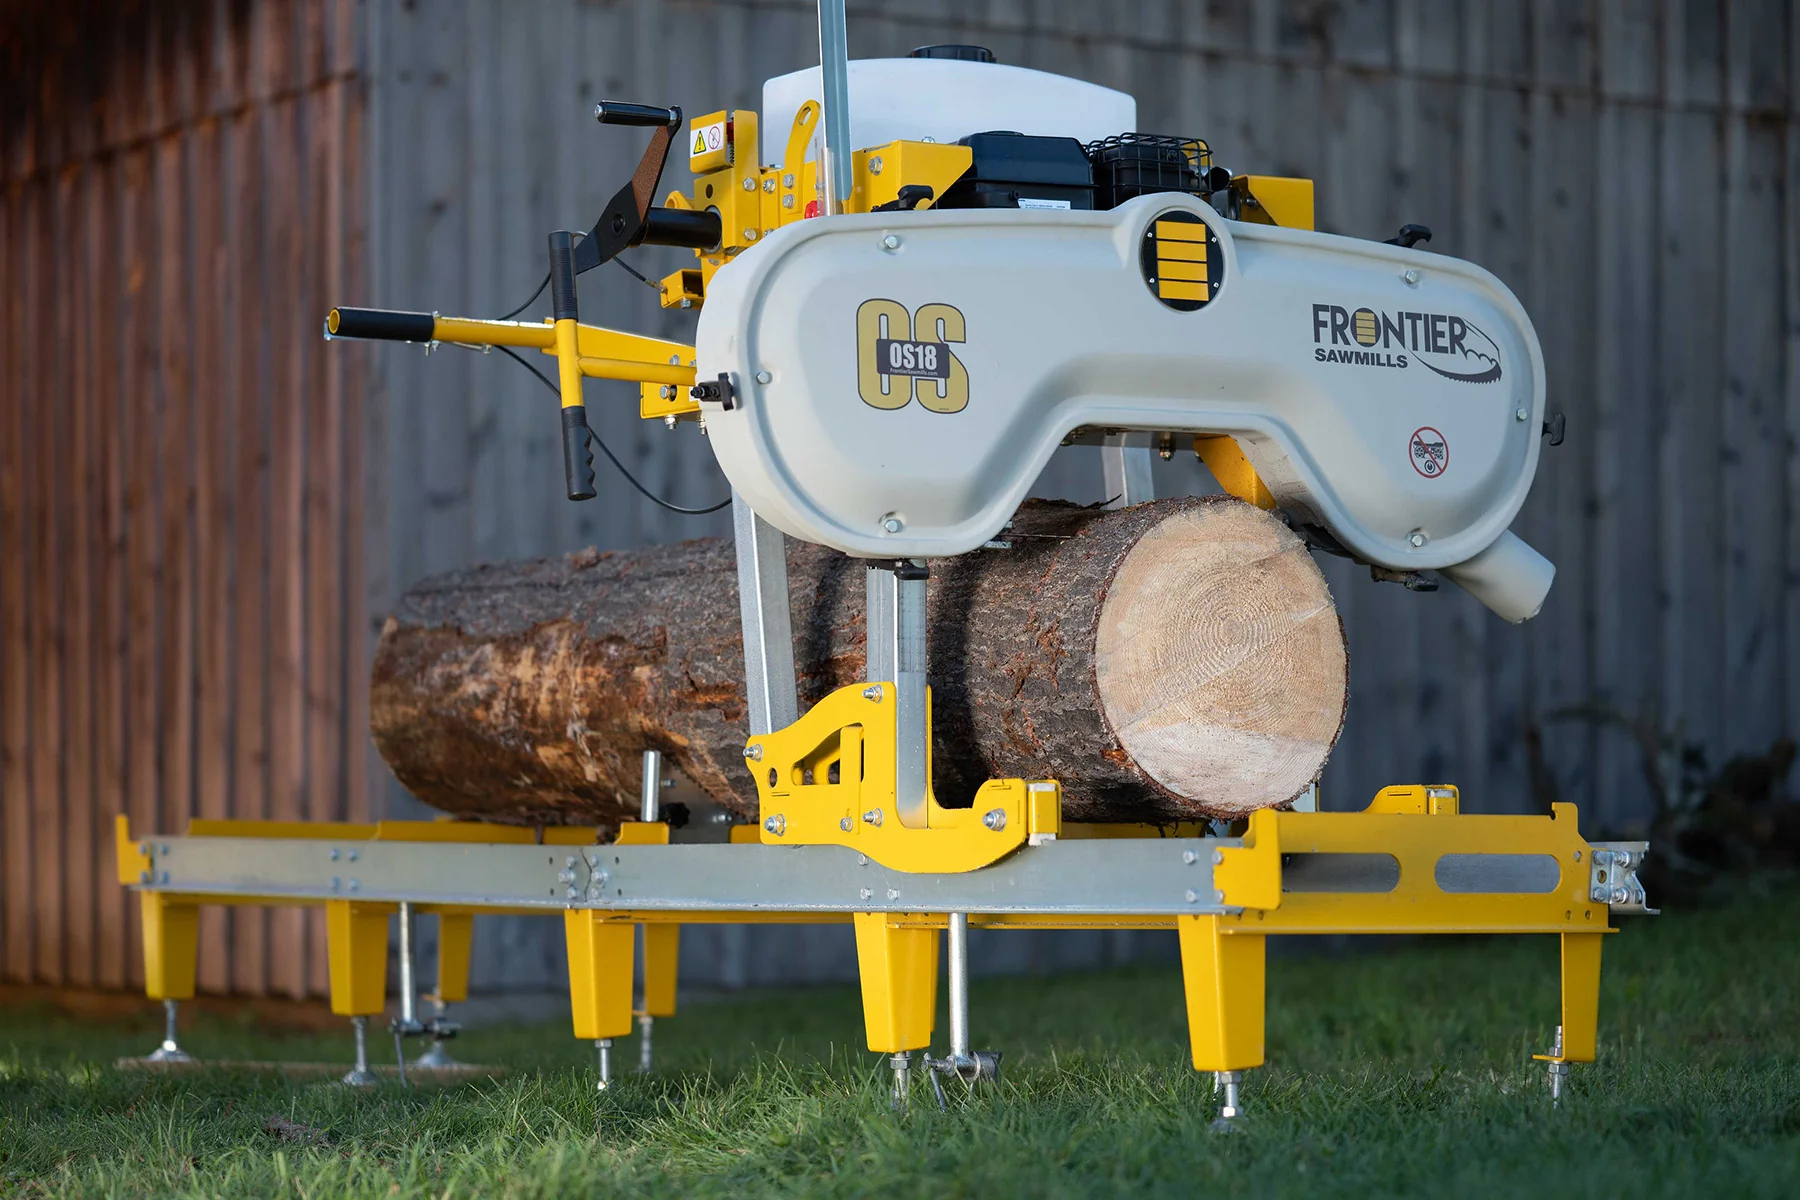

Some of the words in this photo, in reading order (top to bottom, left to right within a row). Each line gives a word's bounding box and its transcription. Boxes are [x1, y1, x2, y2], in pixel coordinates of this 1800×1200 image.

[1312, 303, 1468, 360] FRONTIER
[856, 298, 970, 414] OS
[889, 342, 938, 371] OS18
[1314, 347, 1408, 369] SAWMILLS
